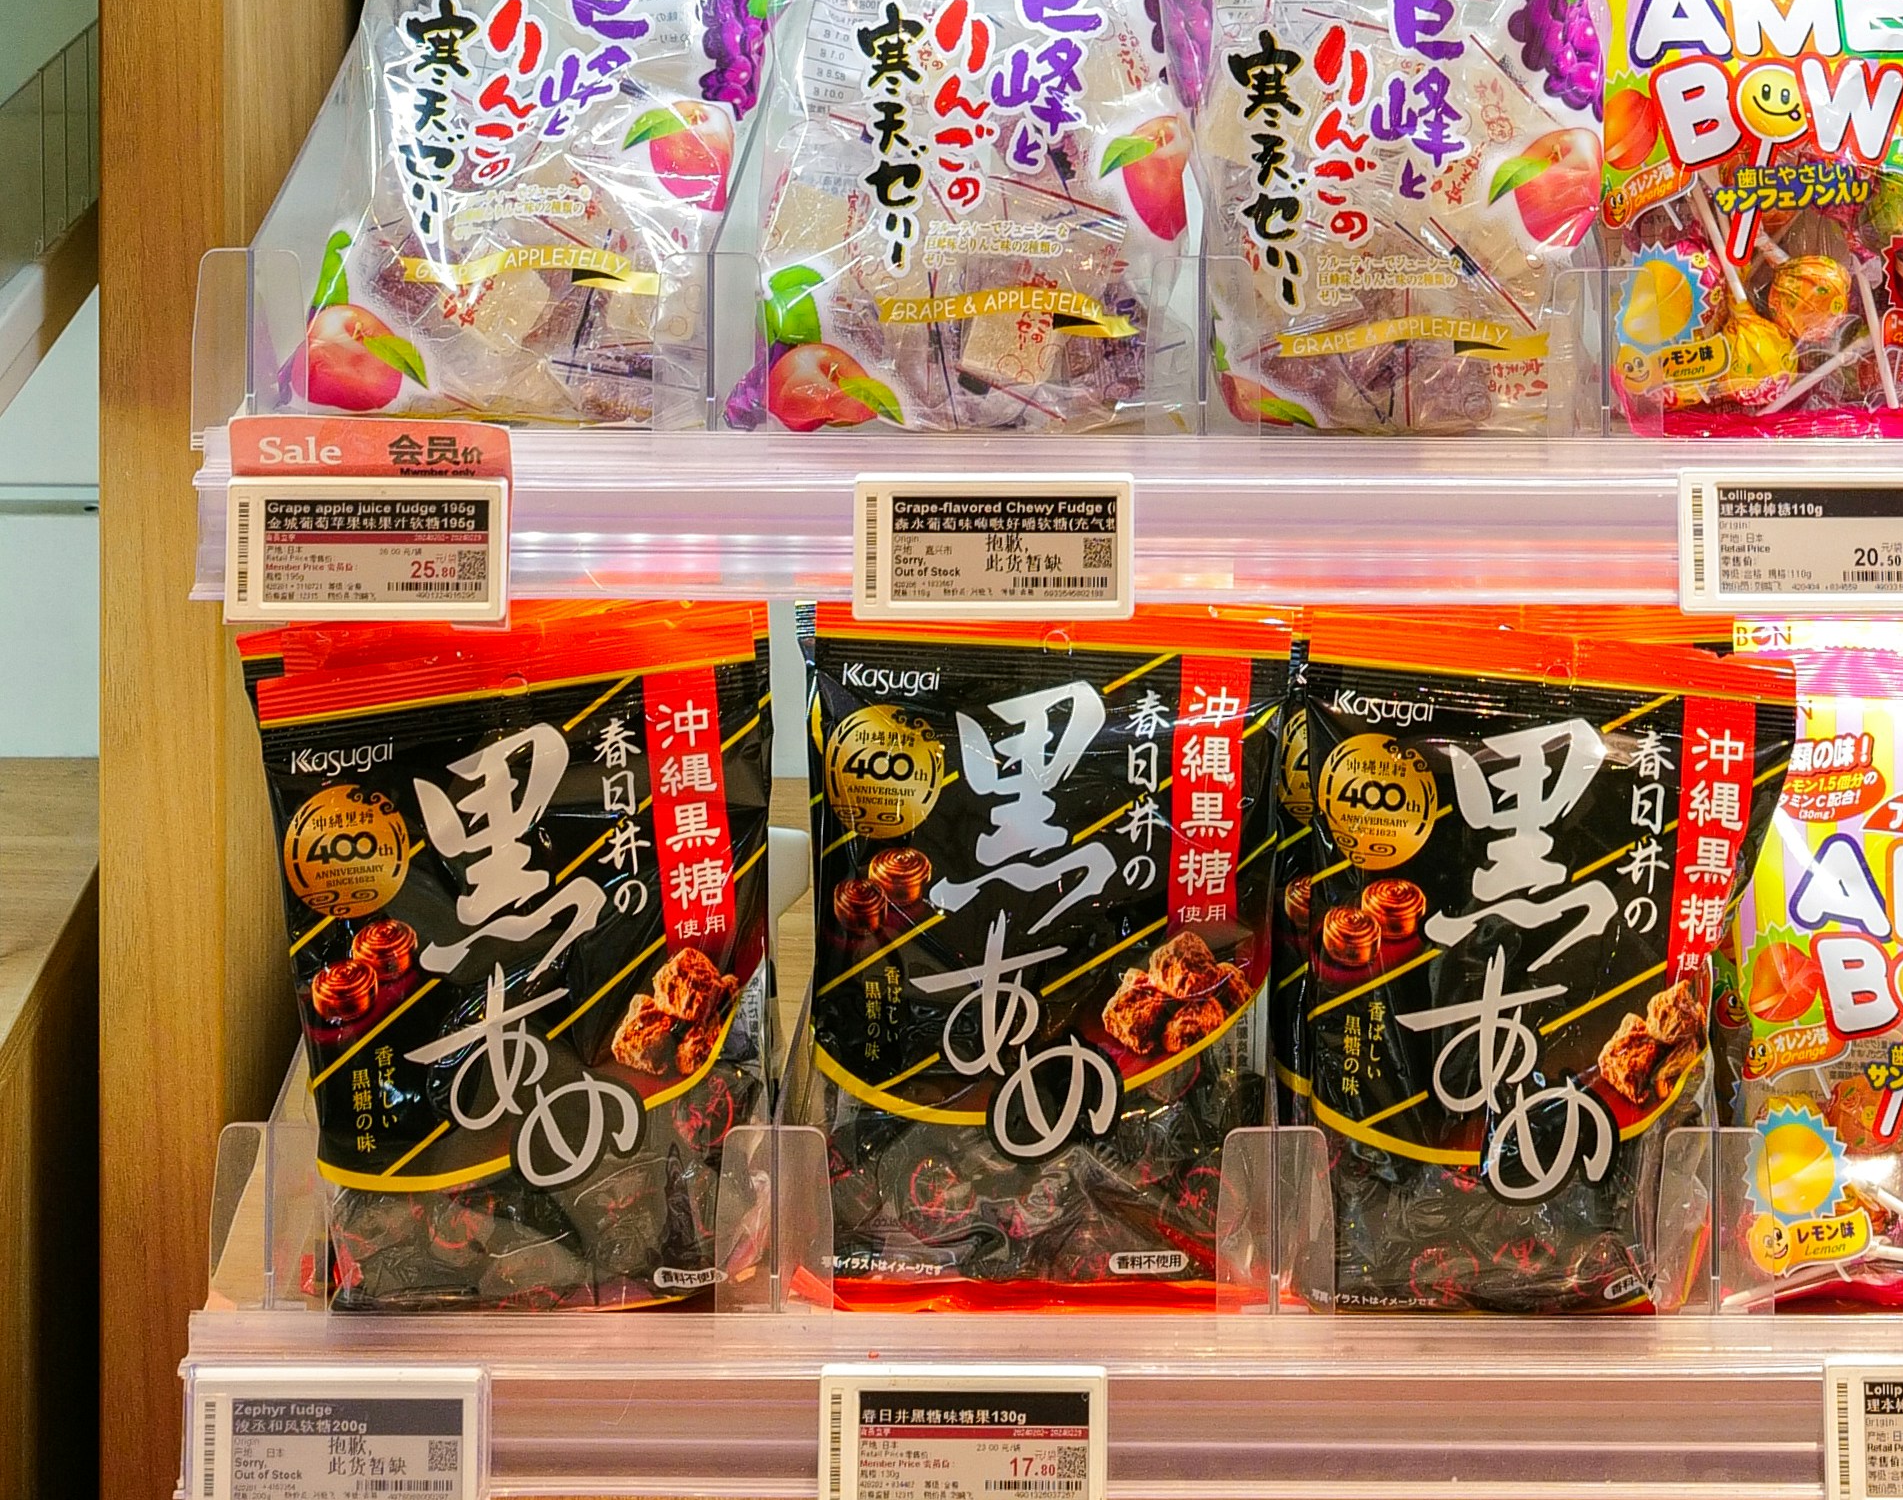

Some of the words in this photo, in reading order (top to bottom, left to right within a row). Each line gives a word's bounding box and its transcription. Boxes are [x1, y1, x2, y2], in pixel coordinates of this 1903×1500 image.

[860, 4, 931, 274] 寒天ゼリー
[260, 436, 342, 466] Sale
[387, 435, 483, 467] 会员价
[266, 502, 313, 516] Grape
[316, 502, 353, 516] apple
[356, 502, 391, 516] juice
[394, 502, 438, 516] fudge
[441, 502, 476, 516] 195g
[410, 560, 456, 578] 25.80
[291, 740, 394, 778] Kasugai
[594, 719, 652, 916] 春日井の
[314, 863, 385, 882] ANNIVERSARY
[1009, 1456, 1056, 1476] 17.80
